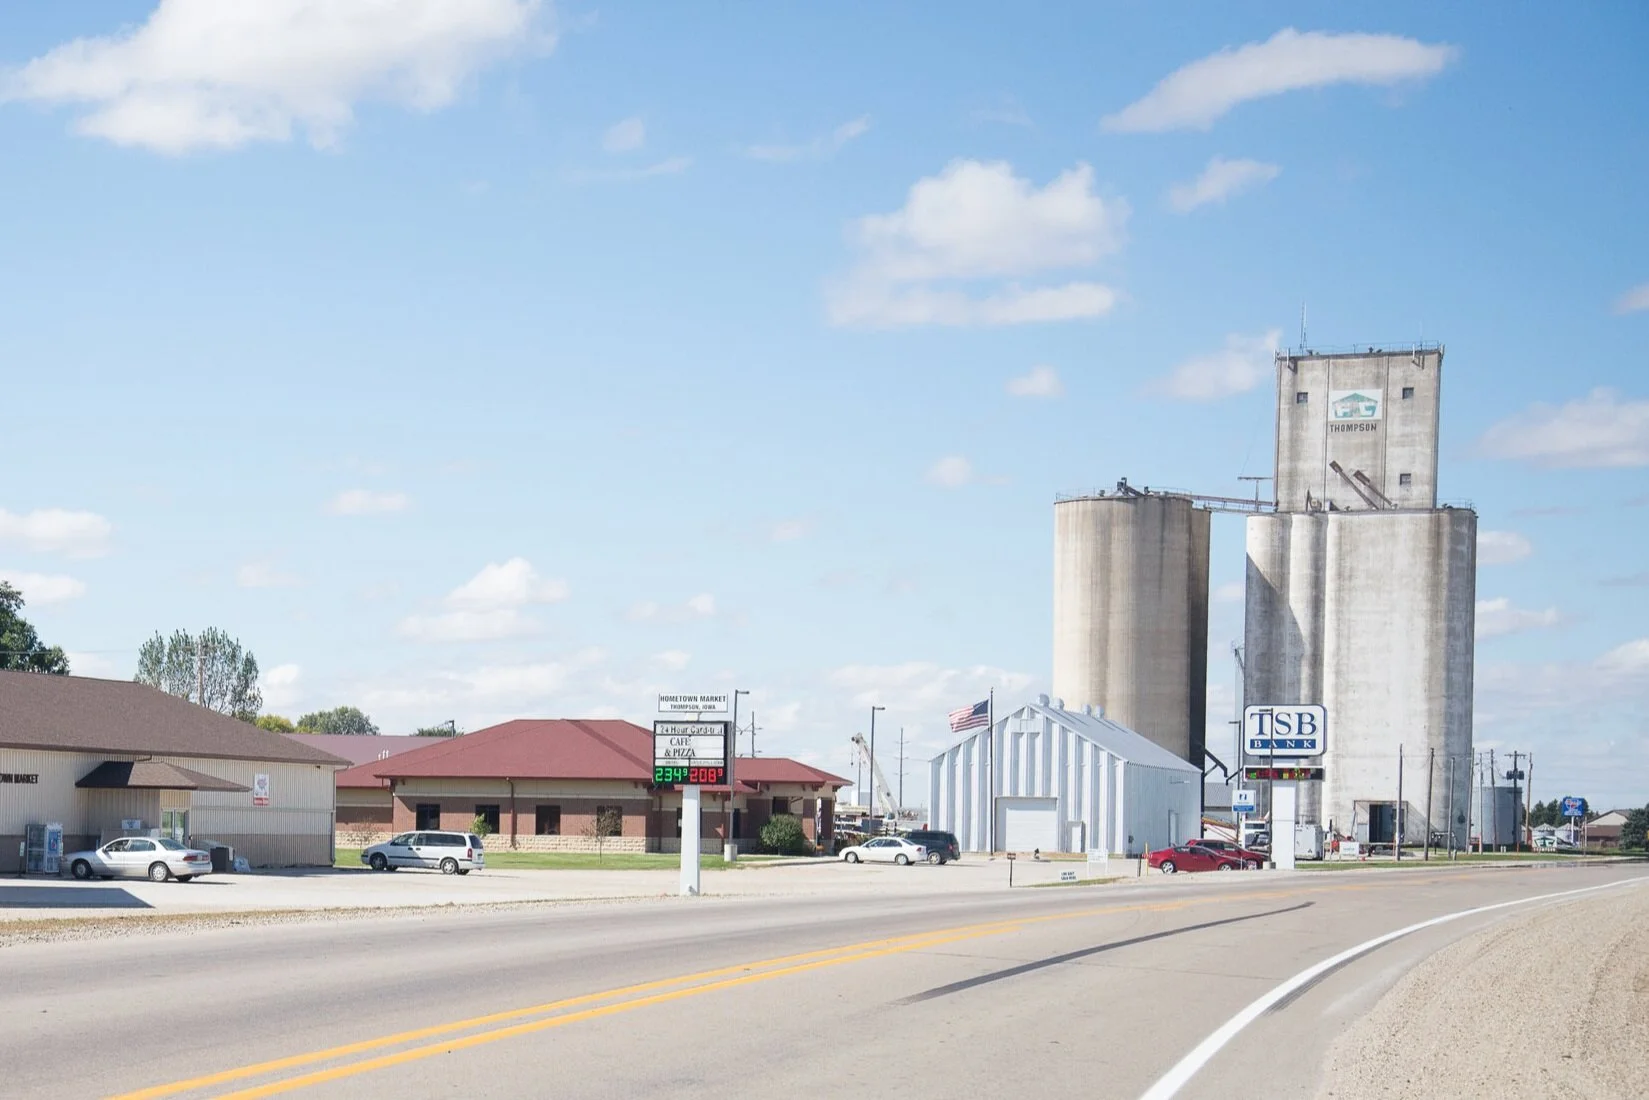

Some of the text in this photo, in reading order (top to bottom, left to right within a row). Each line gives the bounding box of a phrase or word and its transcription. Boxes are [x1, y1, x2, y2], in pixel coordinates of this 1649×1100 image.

[1330, 423, 1377, 433] THOMPSON
[1249, 712, 1317, 736] TSB
[660, 725, 669, 733] 24
[670, 726, 688, 734] Hour
[1254, 740, 1312, 748] BANK
[664, 748, 696, 757] & PIZZA
[14, 774, 39, 784] MARKET
